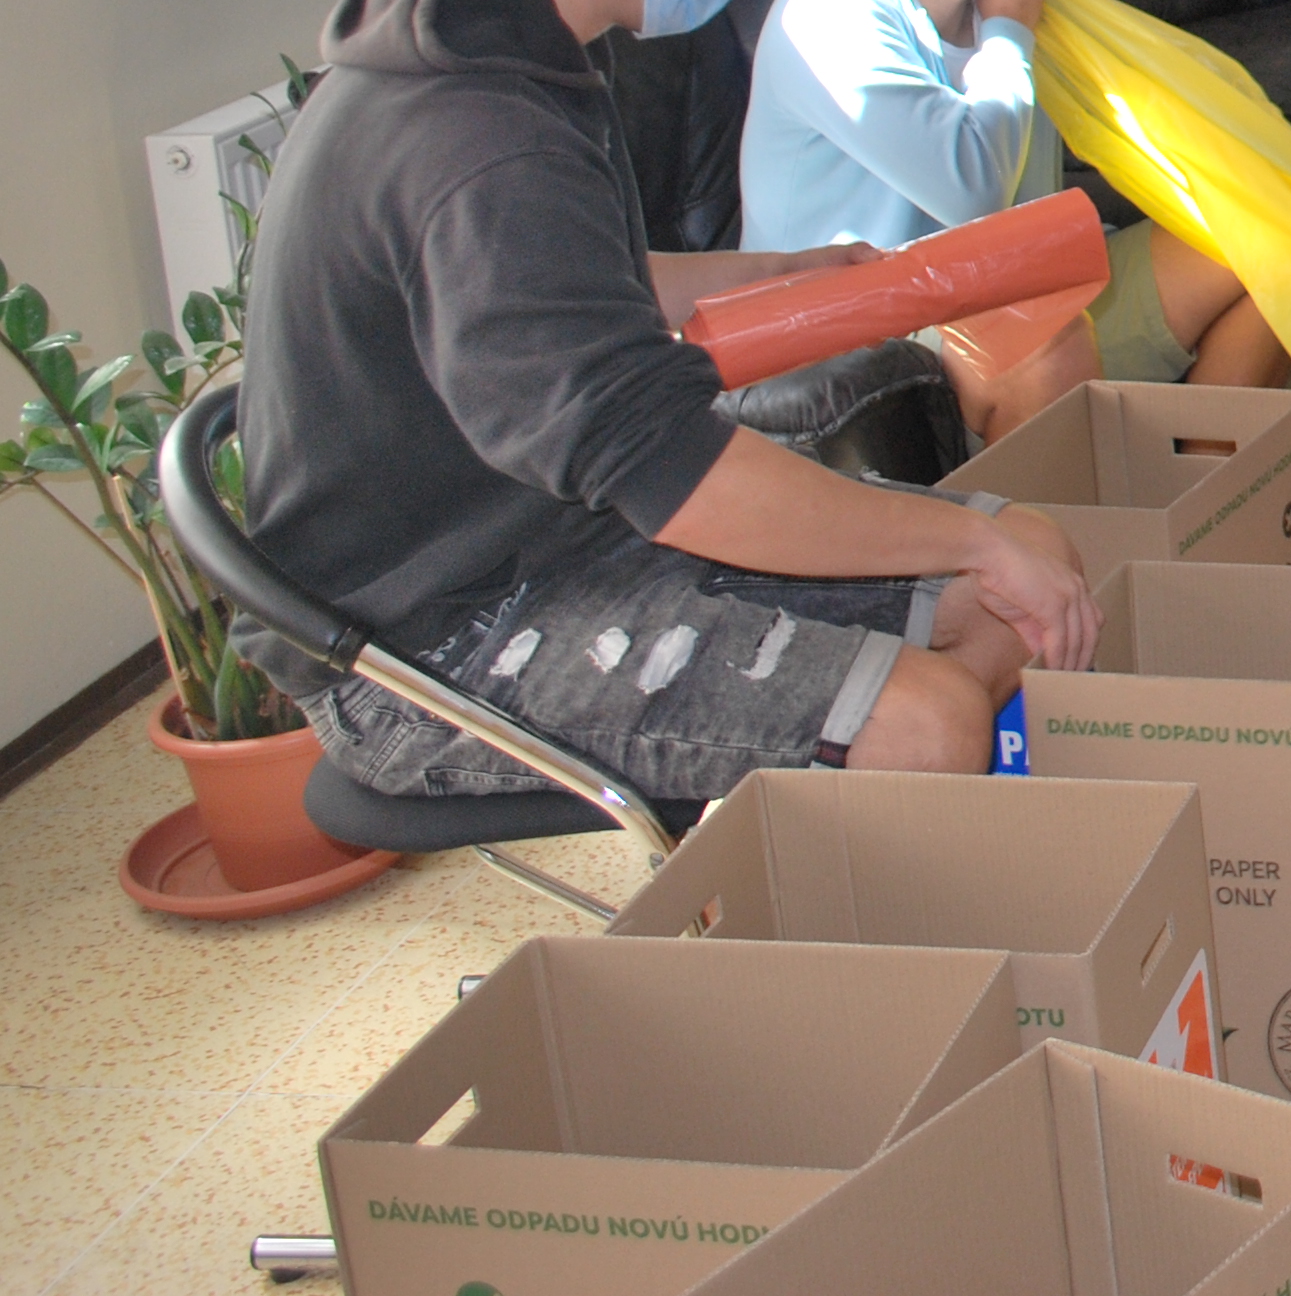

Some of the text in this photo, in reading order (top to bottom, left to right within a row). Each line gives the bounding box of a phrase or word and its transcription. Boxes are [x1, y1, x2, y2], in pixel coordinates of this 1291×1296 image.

[1046, 715, 1135, 739] DÁVAME
[1140, 723, 1230, 744] ODPADU
[999, 730, 1031, 766] P
[1209, 858, 1281, 880] PAPER
[1216, 886, 1277, 907] ONLY
[367, 1197, 479, 1227] DÁVAME
[487, 1208, 600, 1236] ODPADU
[608, 1215, 689, 1242] NOVÚ
